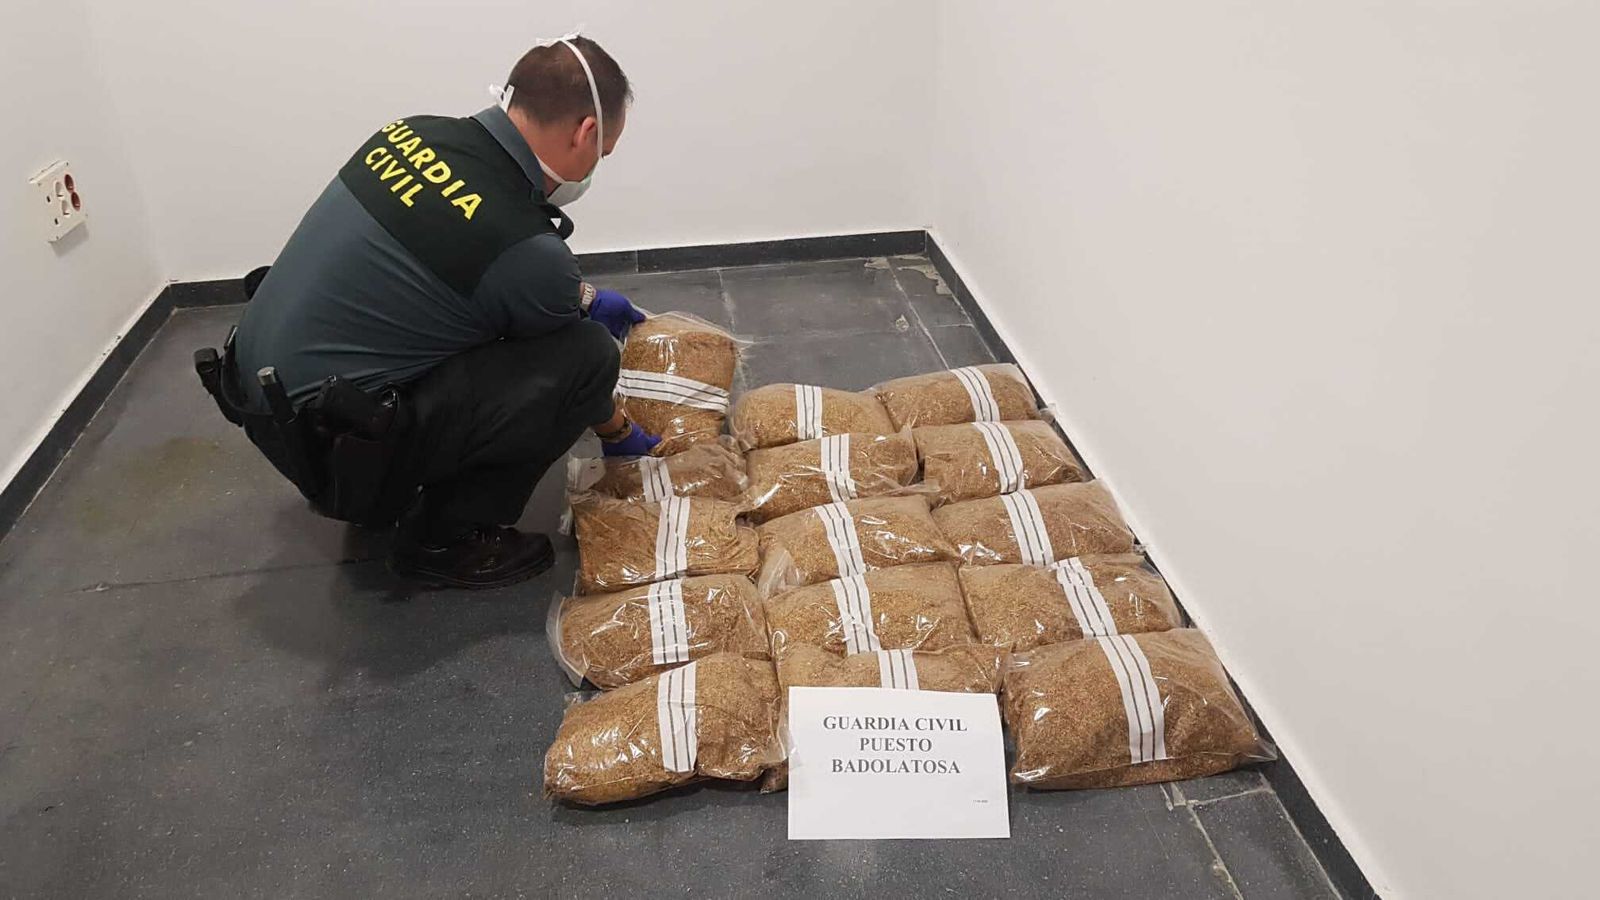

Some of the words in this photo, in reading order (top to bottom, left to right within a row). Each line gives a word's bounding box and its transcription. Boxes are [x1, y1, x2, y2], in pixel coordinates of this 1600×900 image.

[365, 146, 424, 208] CIVIL
[381, 119, 483, 220] GUARDIA
[823, 716, 910, 731] GUARDIA
[915, 717, 968, 732] CIVIL
[860, 737, 932, 752] PUESTO
[832, 758, 961, 774] BADOLATOSA
